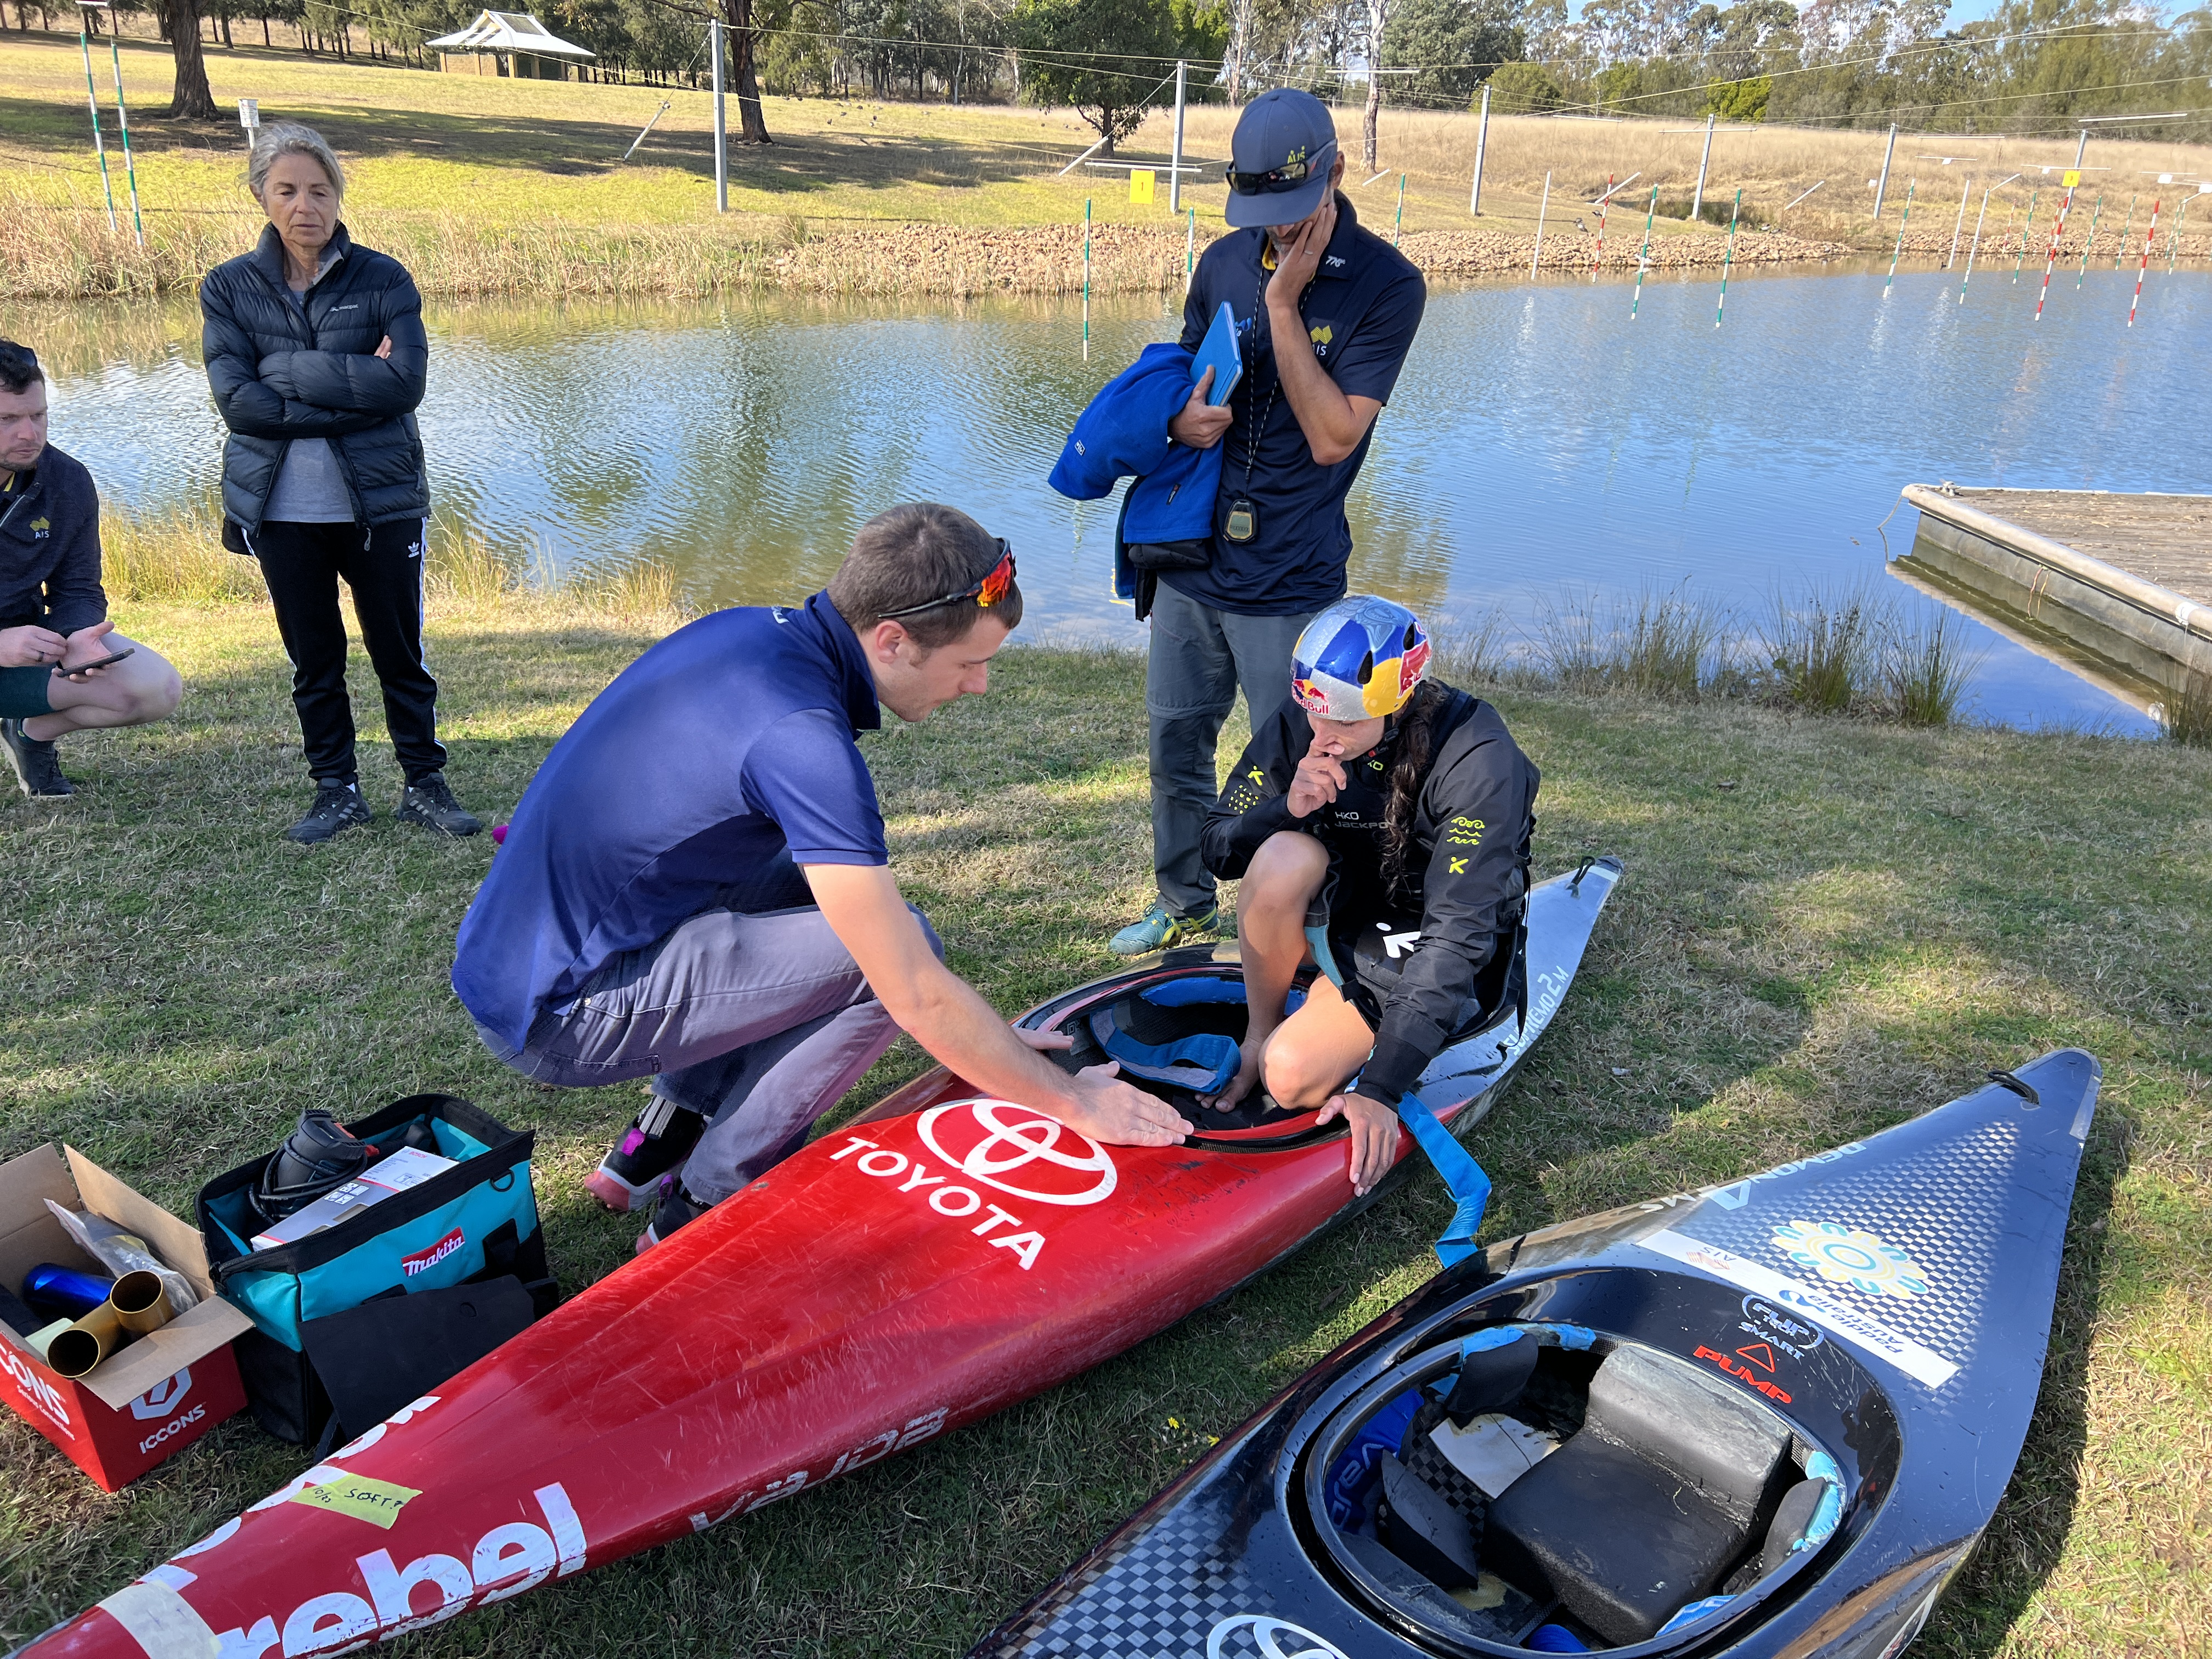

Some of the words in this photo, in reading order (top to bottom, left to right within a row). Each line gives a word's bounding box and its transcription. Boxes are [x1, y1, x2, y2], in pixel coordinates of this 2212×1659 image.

[1312, 344, 1327, 356] IS
[35, 531, 49, 539] AIS
[1307, 701, 1329, 714] Bull
[1368, 759, 1384, 771] KO
[1502, 992, 1556, 1056] SUPREMO
[1746, 1141, 1867, 1184] DEMON
[830, 1136, 1046, 1271] TOYOTA
[1700, 1246, 1737, 1261] AIS
[1738, 1321, 1805, 1360] SMART
[1808, 1295, 1906, 1345] Australia
[1830, 1314, 1904, 1353] Paddle
[1692, 1345, 1792, 1403] PUMP
[139, 1404, 206, 1454] ICCONS
[215, 1482, 587, 1659] rebel
